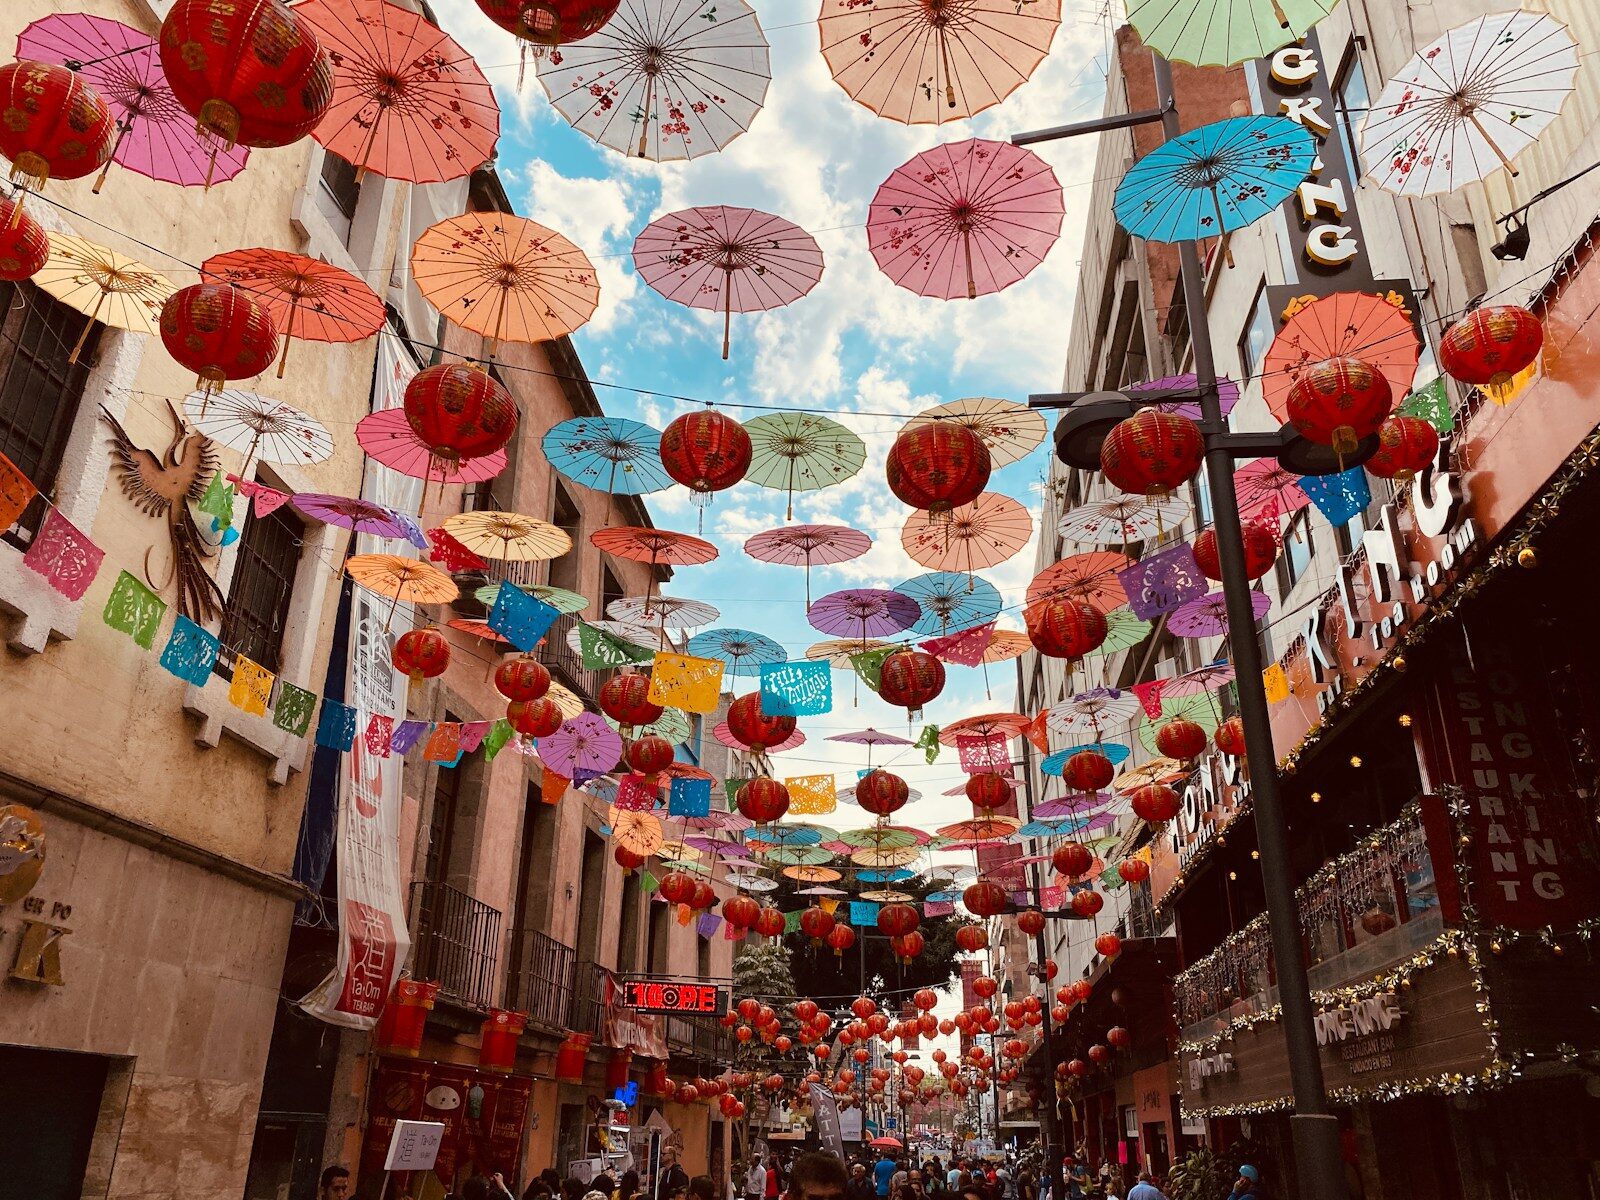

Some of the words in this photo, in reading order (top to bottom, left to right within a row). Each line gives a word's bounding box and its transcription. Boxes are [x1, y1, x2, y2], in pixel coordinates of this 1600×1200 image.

[1280, 97, 1358, 266] KNG
[1299, 435, 1454, 684] KING
[1316, 673, 1342, 714] Bar
[1369, 601, 1404, 650] Tea
[1410, 518, 1476, 605] Room
[1452, 666, 1521, 901] ESTAURANT
[1488, 668, 1533, 759] ONG
[1508, 773, 1565, 900] KING
